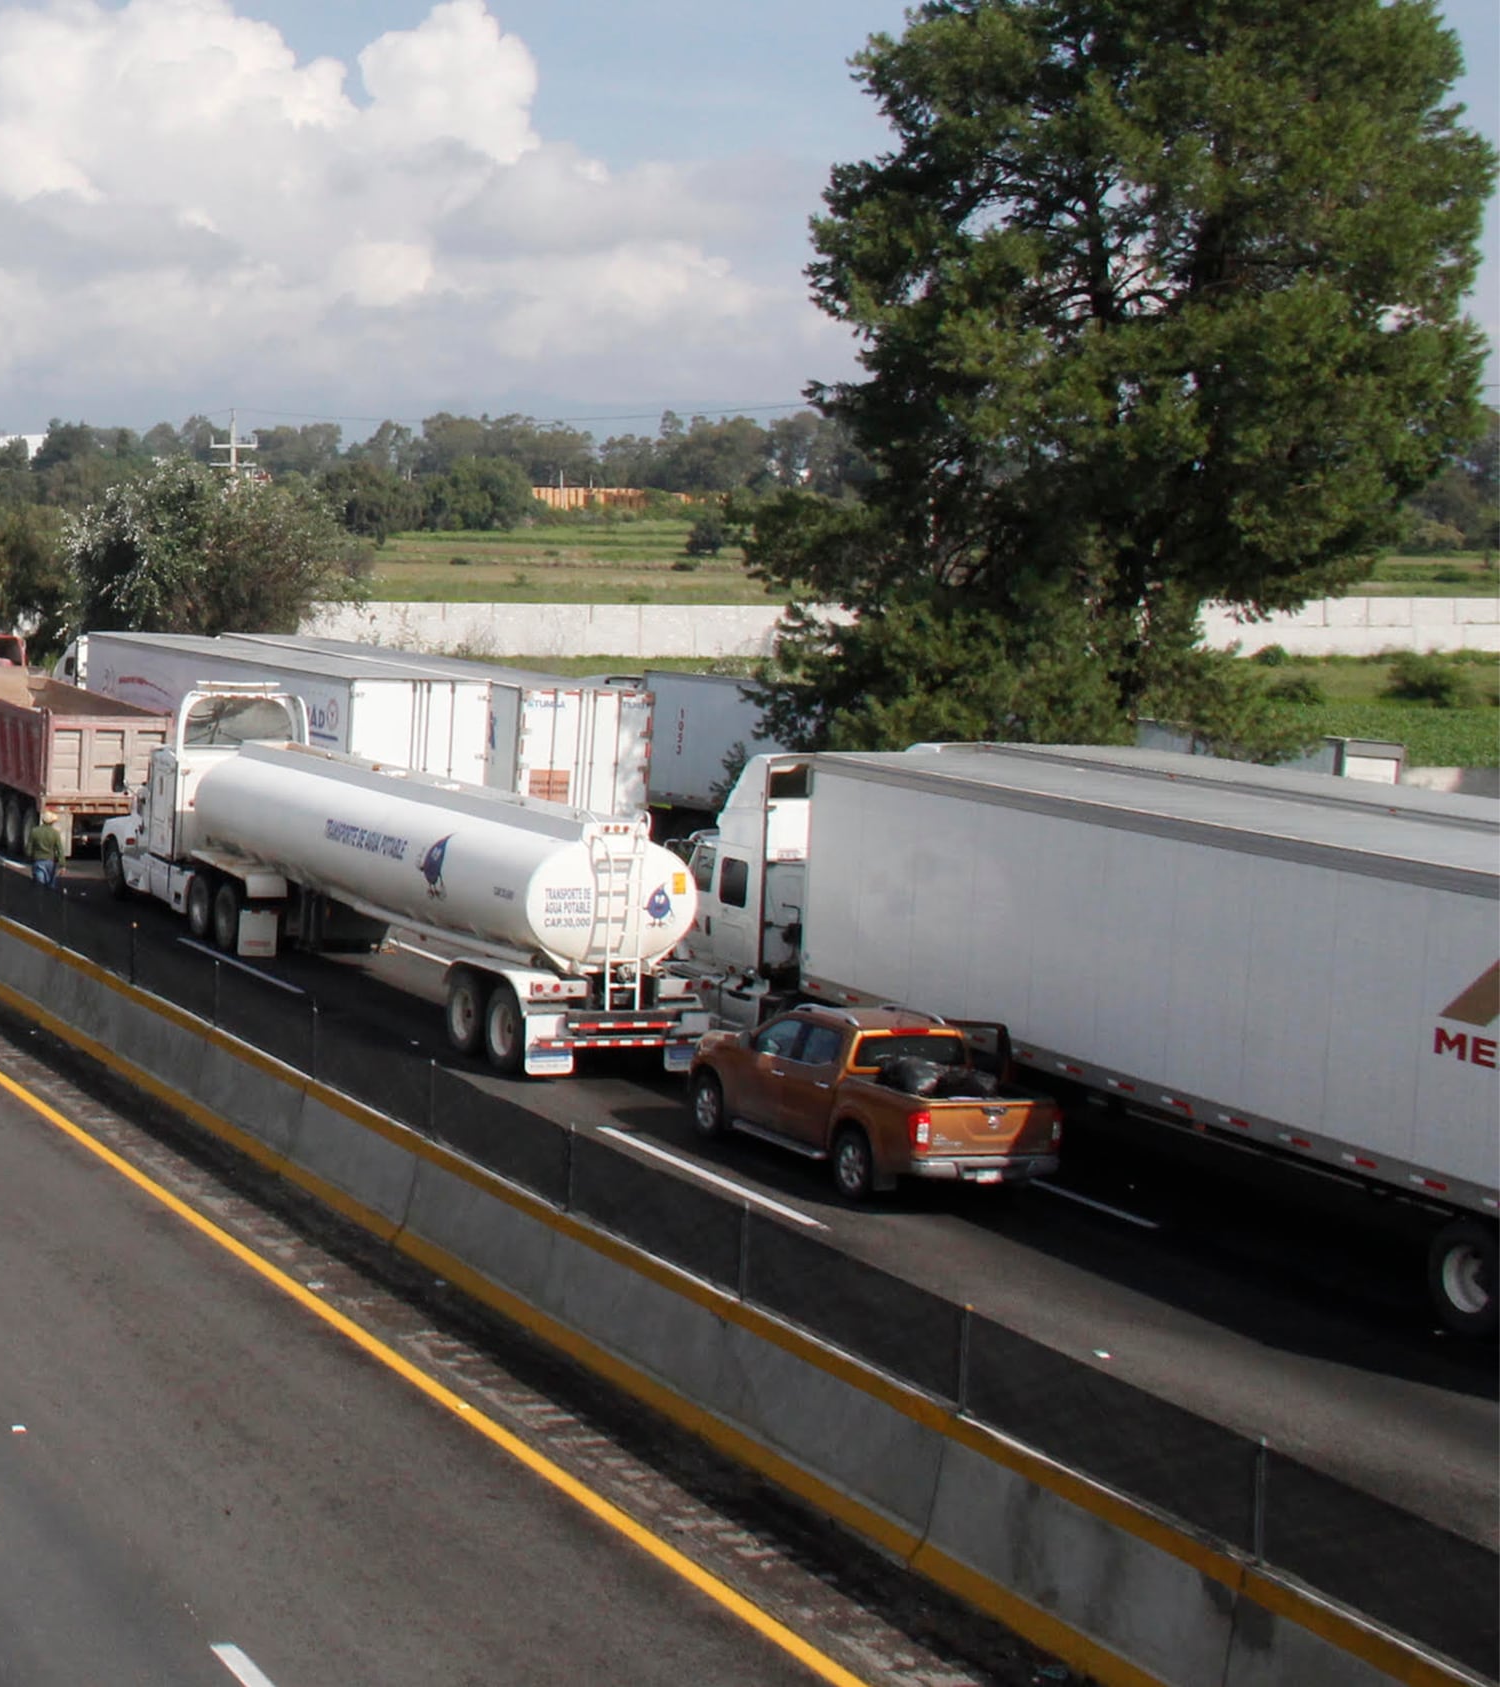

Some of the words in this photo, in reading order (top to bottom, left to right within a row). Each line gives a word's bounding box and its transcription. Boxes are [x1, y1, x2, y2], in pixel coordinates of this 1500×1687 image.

[325, 819, 360, 847] TRANSPORTE
[381, 835, 408, 860] POTABLE
[545, 887, 582, 900] TRANSPORTE
[583, 887, 591, 900] DE
[545, 901, 562, 914] AGUA
[563, 901, 591, 914] POTABLE
[1433, 1026, 1498, 1069] ME
